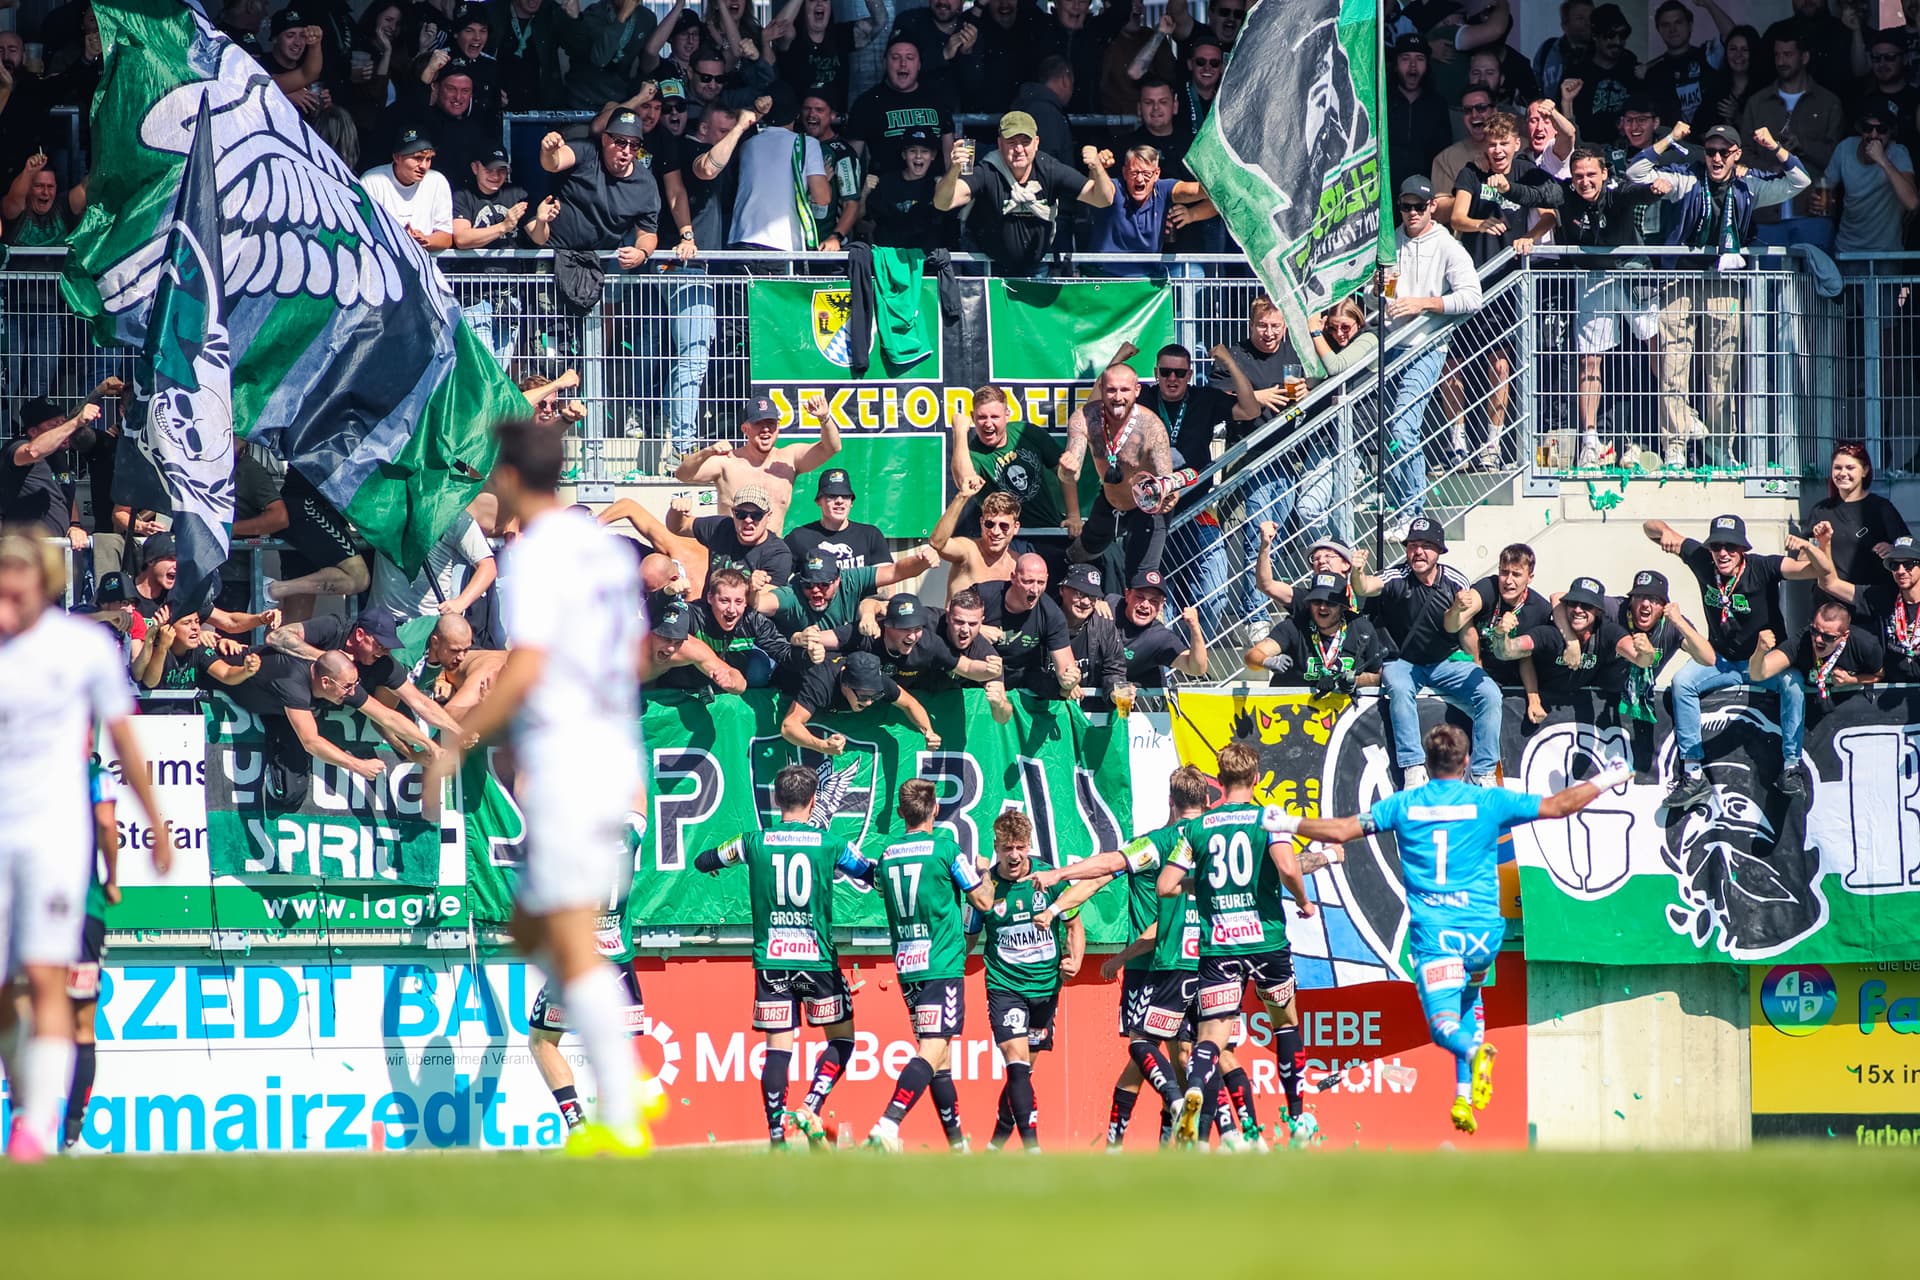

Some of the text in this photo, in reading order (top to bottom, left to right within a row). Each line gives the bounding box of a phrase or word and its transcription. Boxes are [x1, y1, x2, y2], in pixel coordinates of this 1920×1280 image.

[885, 108, 940, 128] RIED
[222, 750, 423, 814] YUNG
[244, 818, 401, 880] SPIRIT
[1207, 831, 1254, 889] 30
[1431, 829, 1449, 885] 1
[771, 852, 813, 908] 10
[887, 862, 923, 919] 17
[1211, 892, 1257, 910] STEURER
[593, 914, 621, 929] ERGER
[769, 911, 814, 926] GROSSE
[1213, 921, 1262, 943] Granit
[768, 938, 818, 958] Granit
[895, 950, 928, 972] Ganit
[1200, 988, 1241, 1010] BAUBAST
[1303, 1011, 1382, 1046] IEBE
[385, 1053, 403, 1065] wir
[406, 1052, 488, 1065] übernehmen
[1855, 1064, 1895, 1084] 15x
